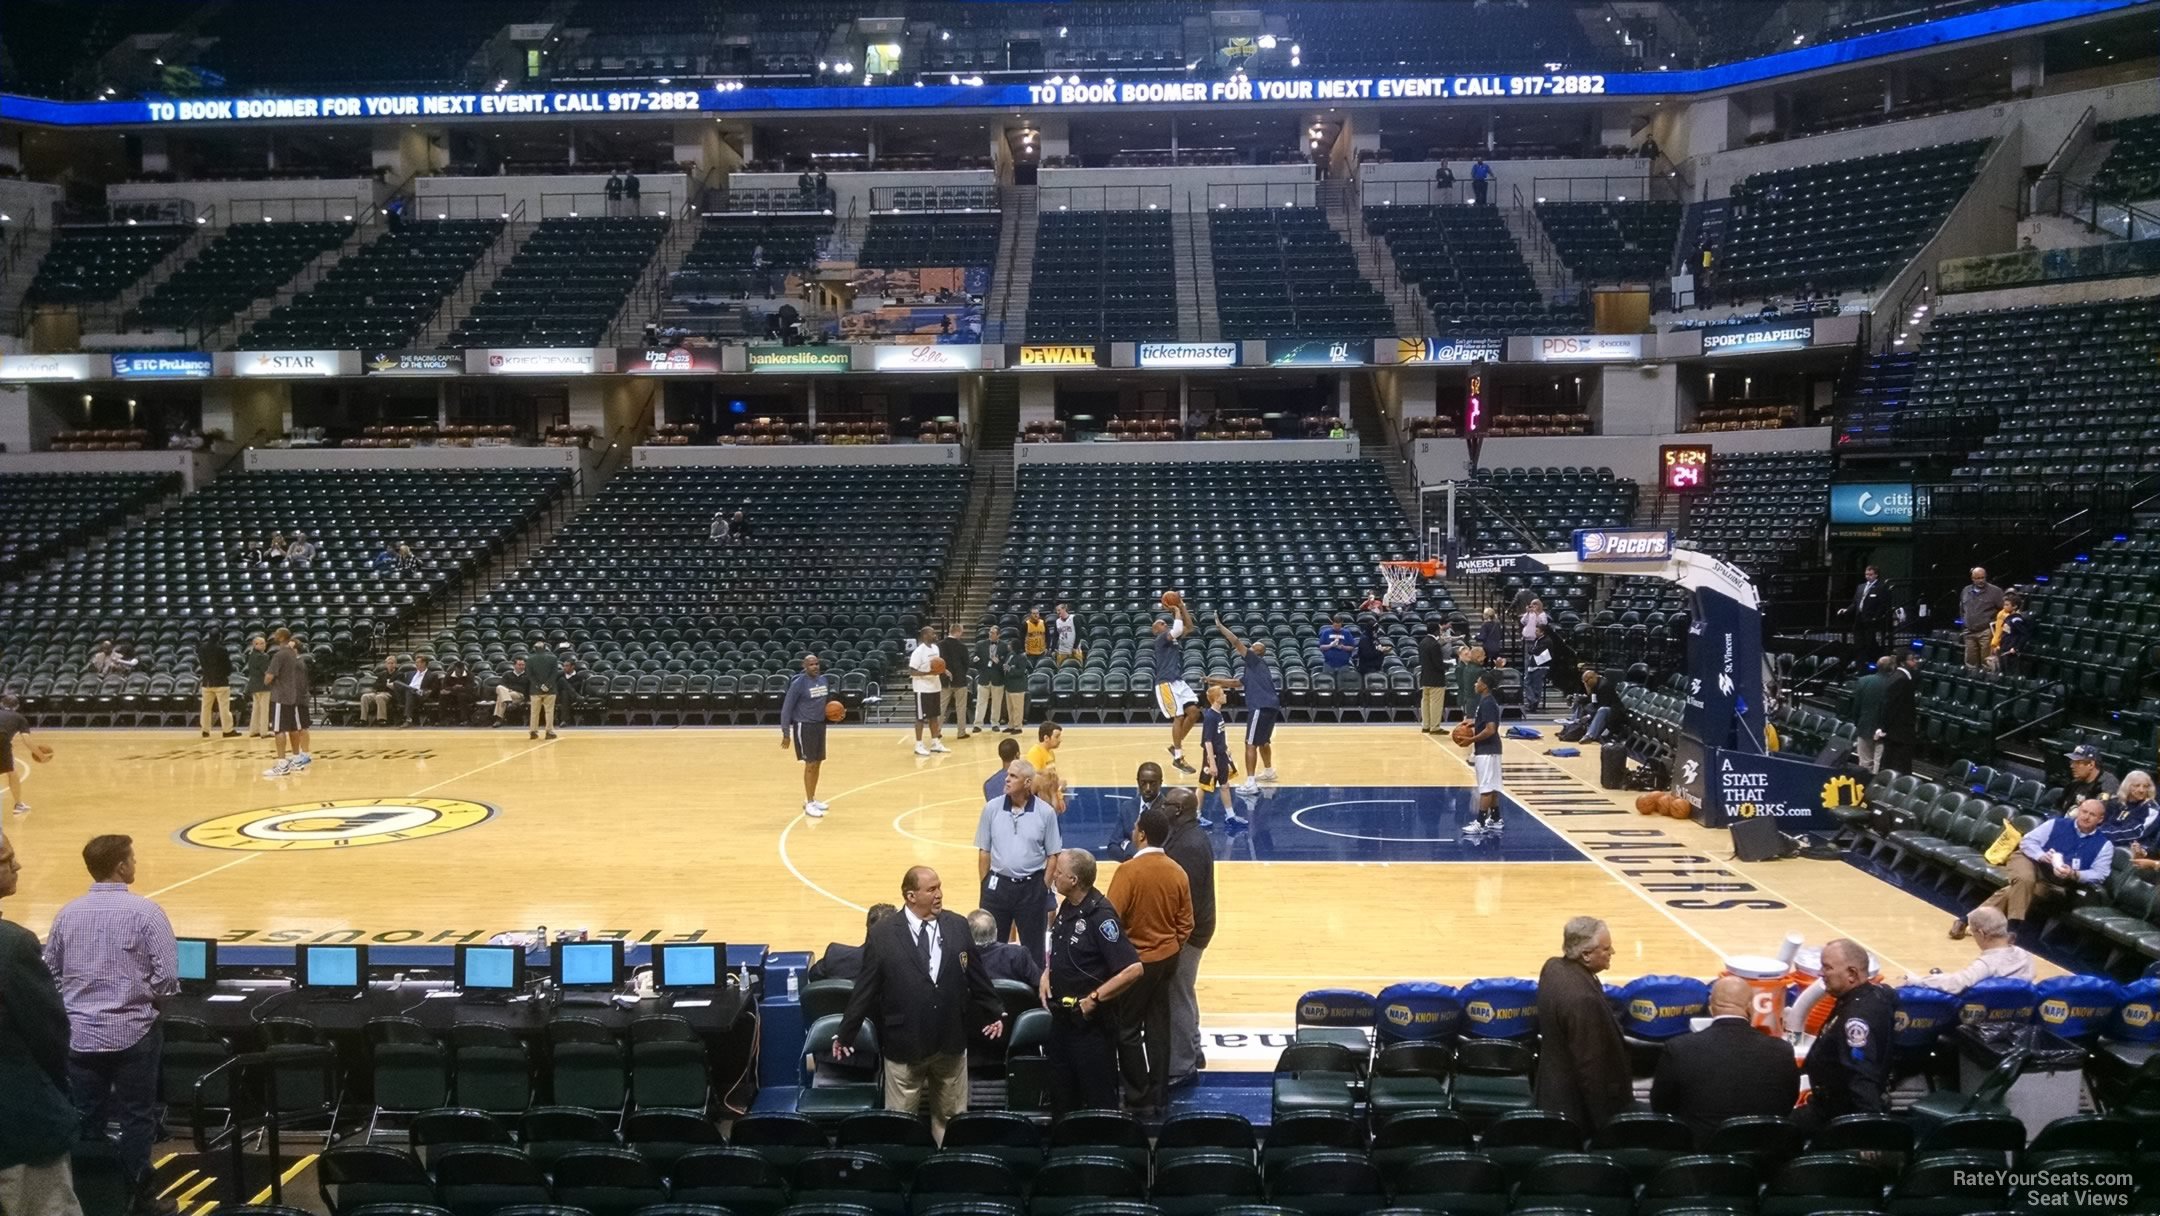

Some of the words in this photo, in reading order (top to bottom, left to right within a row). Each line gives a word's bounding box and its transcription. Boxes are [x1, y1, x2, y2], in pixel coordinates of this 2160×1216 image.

[1029, 85, 1056, 103] TO
[1061, 84, 1116, 103] BOOK
[1122, 82, 1207, 102] BOOMER
[1212, 82, 1252, 100] FOR
[1258, 81, 1313, 99] YOUR
[1318, 79, 1373, 98] NEXT
[1378, 78, 1448, 98] EVENT,
[1454, 77, 1505, 95] CALL
[1511, 75, 1605, 95] 917-2882
[149, 102, 175, 121] TO
[179, 101, 231, 120] BOOK
[236, 100, 318, 118] BOOMER
[322, 98, 361, 116] FOR
[365, 96, 419, 115] YOUR
[423, 94, 476, 114] NEXT
[481, 94, 549, 114] EVENT,
[553, 93, 604, 111] CALL
[608, 92, 699, 111] 917-2882
[1704, 331, 1745, 348] SPORT
[1746, 327, 1811, 344] GRAPHICS
[1542, 338, 1577, 353] PDS
[645, 351, 667, 361] the
[749, 352, 848, 365] bankerslife.com
[909, 346, 949, 364] Lilly
[1142, 345, 1235, 360] ticketmaster
[1329, 343, 1348, 362] ipl
[1438, 345, 1500, 362] @Pacers
[133, 360, 158, 370] ETC
[159, 359, 211, 370] ProLiance
[273, 356, 315, 368] STAR
[543, 356, 592, 364] DEVAULT
[947, 448, 954, 458] 16
[1022, 448, 1029, 457] 17
[1346, 444, 1353, 453] 17
[1421, 443, 1429, 453] 18
[565, 451, 573, 462] 15
[1665, 452, 1706, 465] 51:24
[1674, 468, 1697, 486] 24
[1607, 536, 1666, 554] Pacers
[1496, 558, 1516, 567] LIFE
[1712, 562, 1745, 590] SPALDING
[1724, 633, 1733, 662] Vincent
[1722, 758, 1733, 771] A
[1723, 774, 1768, 786] STATE
[1723, 788, 1765, 801] THAT
[1566, 829, 1788, 910] PACERS
[1753, 992, 1773, 1014] G
[1304, 1006, 1325, 1017] NAPA
[1330, 1008, 1354, 1017] KNOW
[1355, 1007, 1375, 1017] HOW
[1390, 1008, 1409, 1021] NAPA
[1414, 1012, 1439, 1022] KNOW
[1440, 1011, 1457, 1021] HOW
[1470, 1006, 1490, 1018] NAPA
[1496, 1008, 1520, 1019] KNOW
[1633, 1005, 1652, 1016] NAPA
[1659, 1006, 1684, 1018] KNOW
[1988, 1009, 2015, 1019] KNOW
[2044, 1005, 2065, 1017] NAPA
[2071, 1007, 2094, 1017] KNOW
[2127, 1008, 2149, 1020] NAPA
